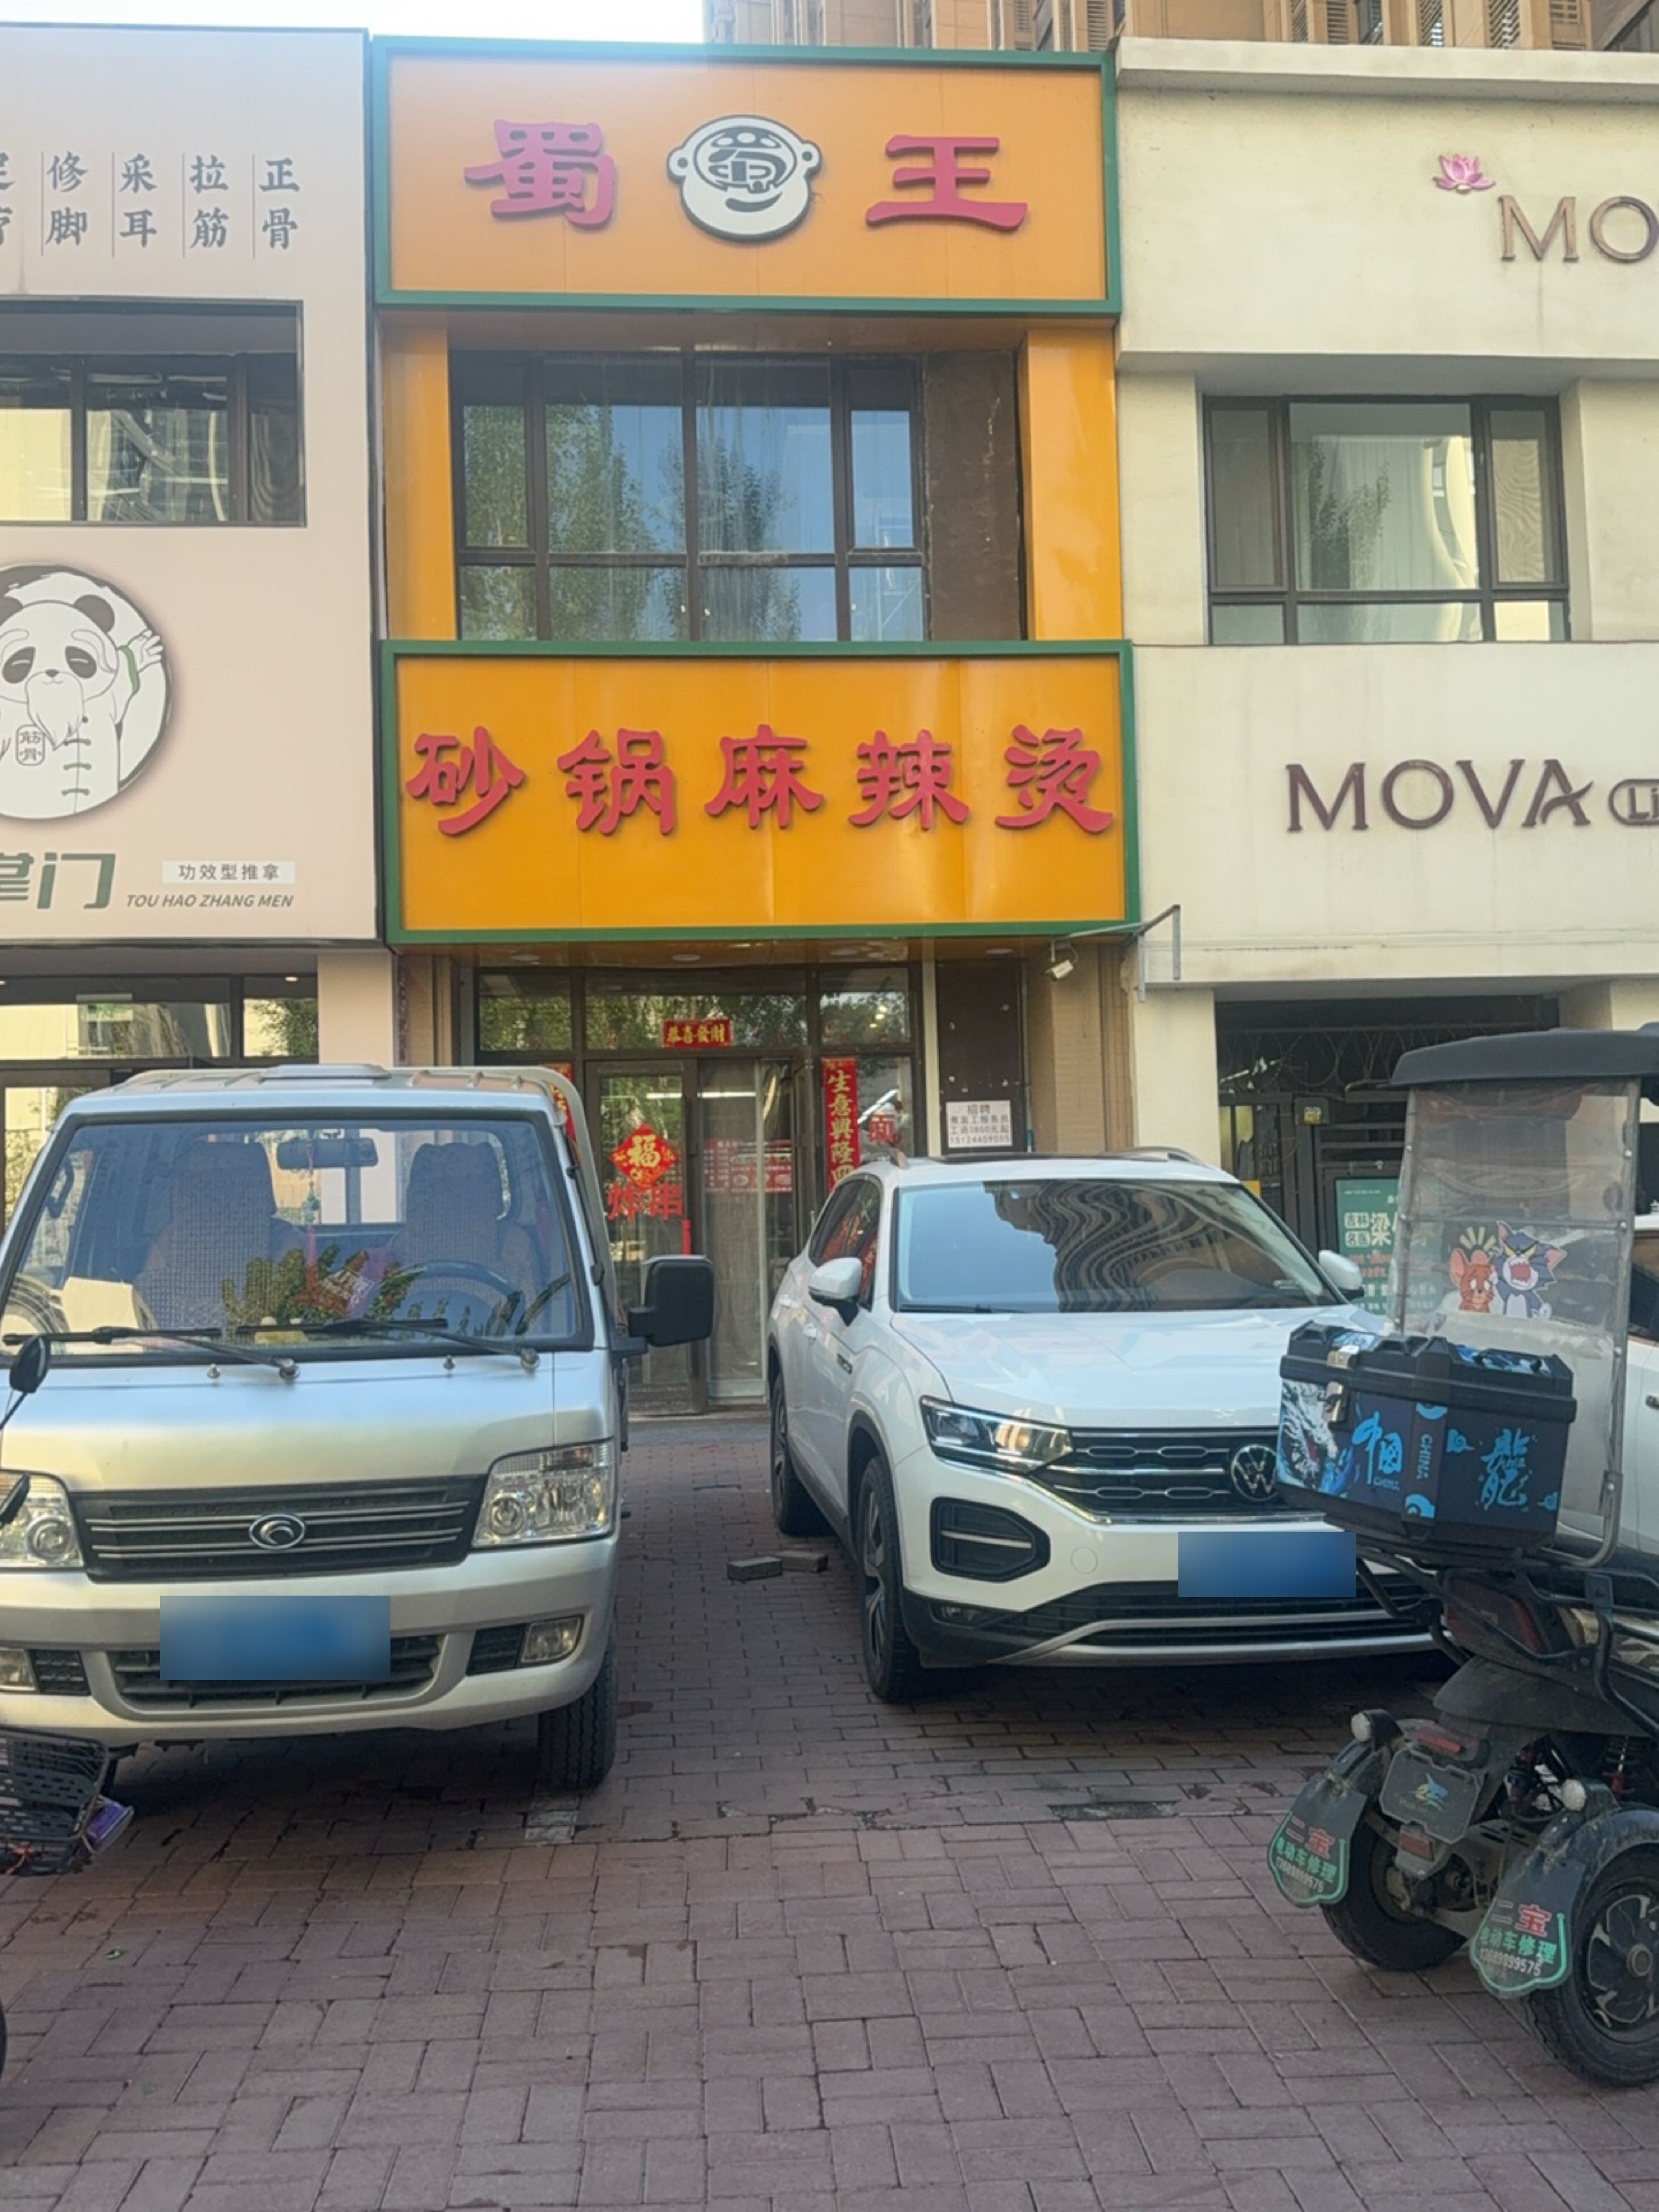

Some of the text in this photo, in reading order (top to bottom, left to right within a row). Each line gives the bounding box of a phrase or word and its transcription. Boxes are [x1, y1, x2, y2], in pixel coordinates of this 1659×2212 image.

[45, 151, 88, 246] 修脚
[119, 153, 157, 248] 采耳
[189, 155, 230, 248] 拉筋
[259, 157, 300, 250] 正骨
[463, 119, 617, 229] 蜀
[866, 134, 1029, 232] 王
[405, 724, 1114, 835] 砂锅麻辣烫
[1285, 758, 1594, 832] MOVA
[126, 894, 294, 908] TOU HAO ZHANG MEN
[178, 863, 280, 881] 功效型推拿
[627, 1134, 661, 1167] 福
[1370, 1212, 1398, 1246] 梁
[1416, 1434, 1433, 1480] CHINA
[1491, 1899, 1553, 1937] 二宝
